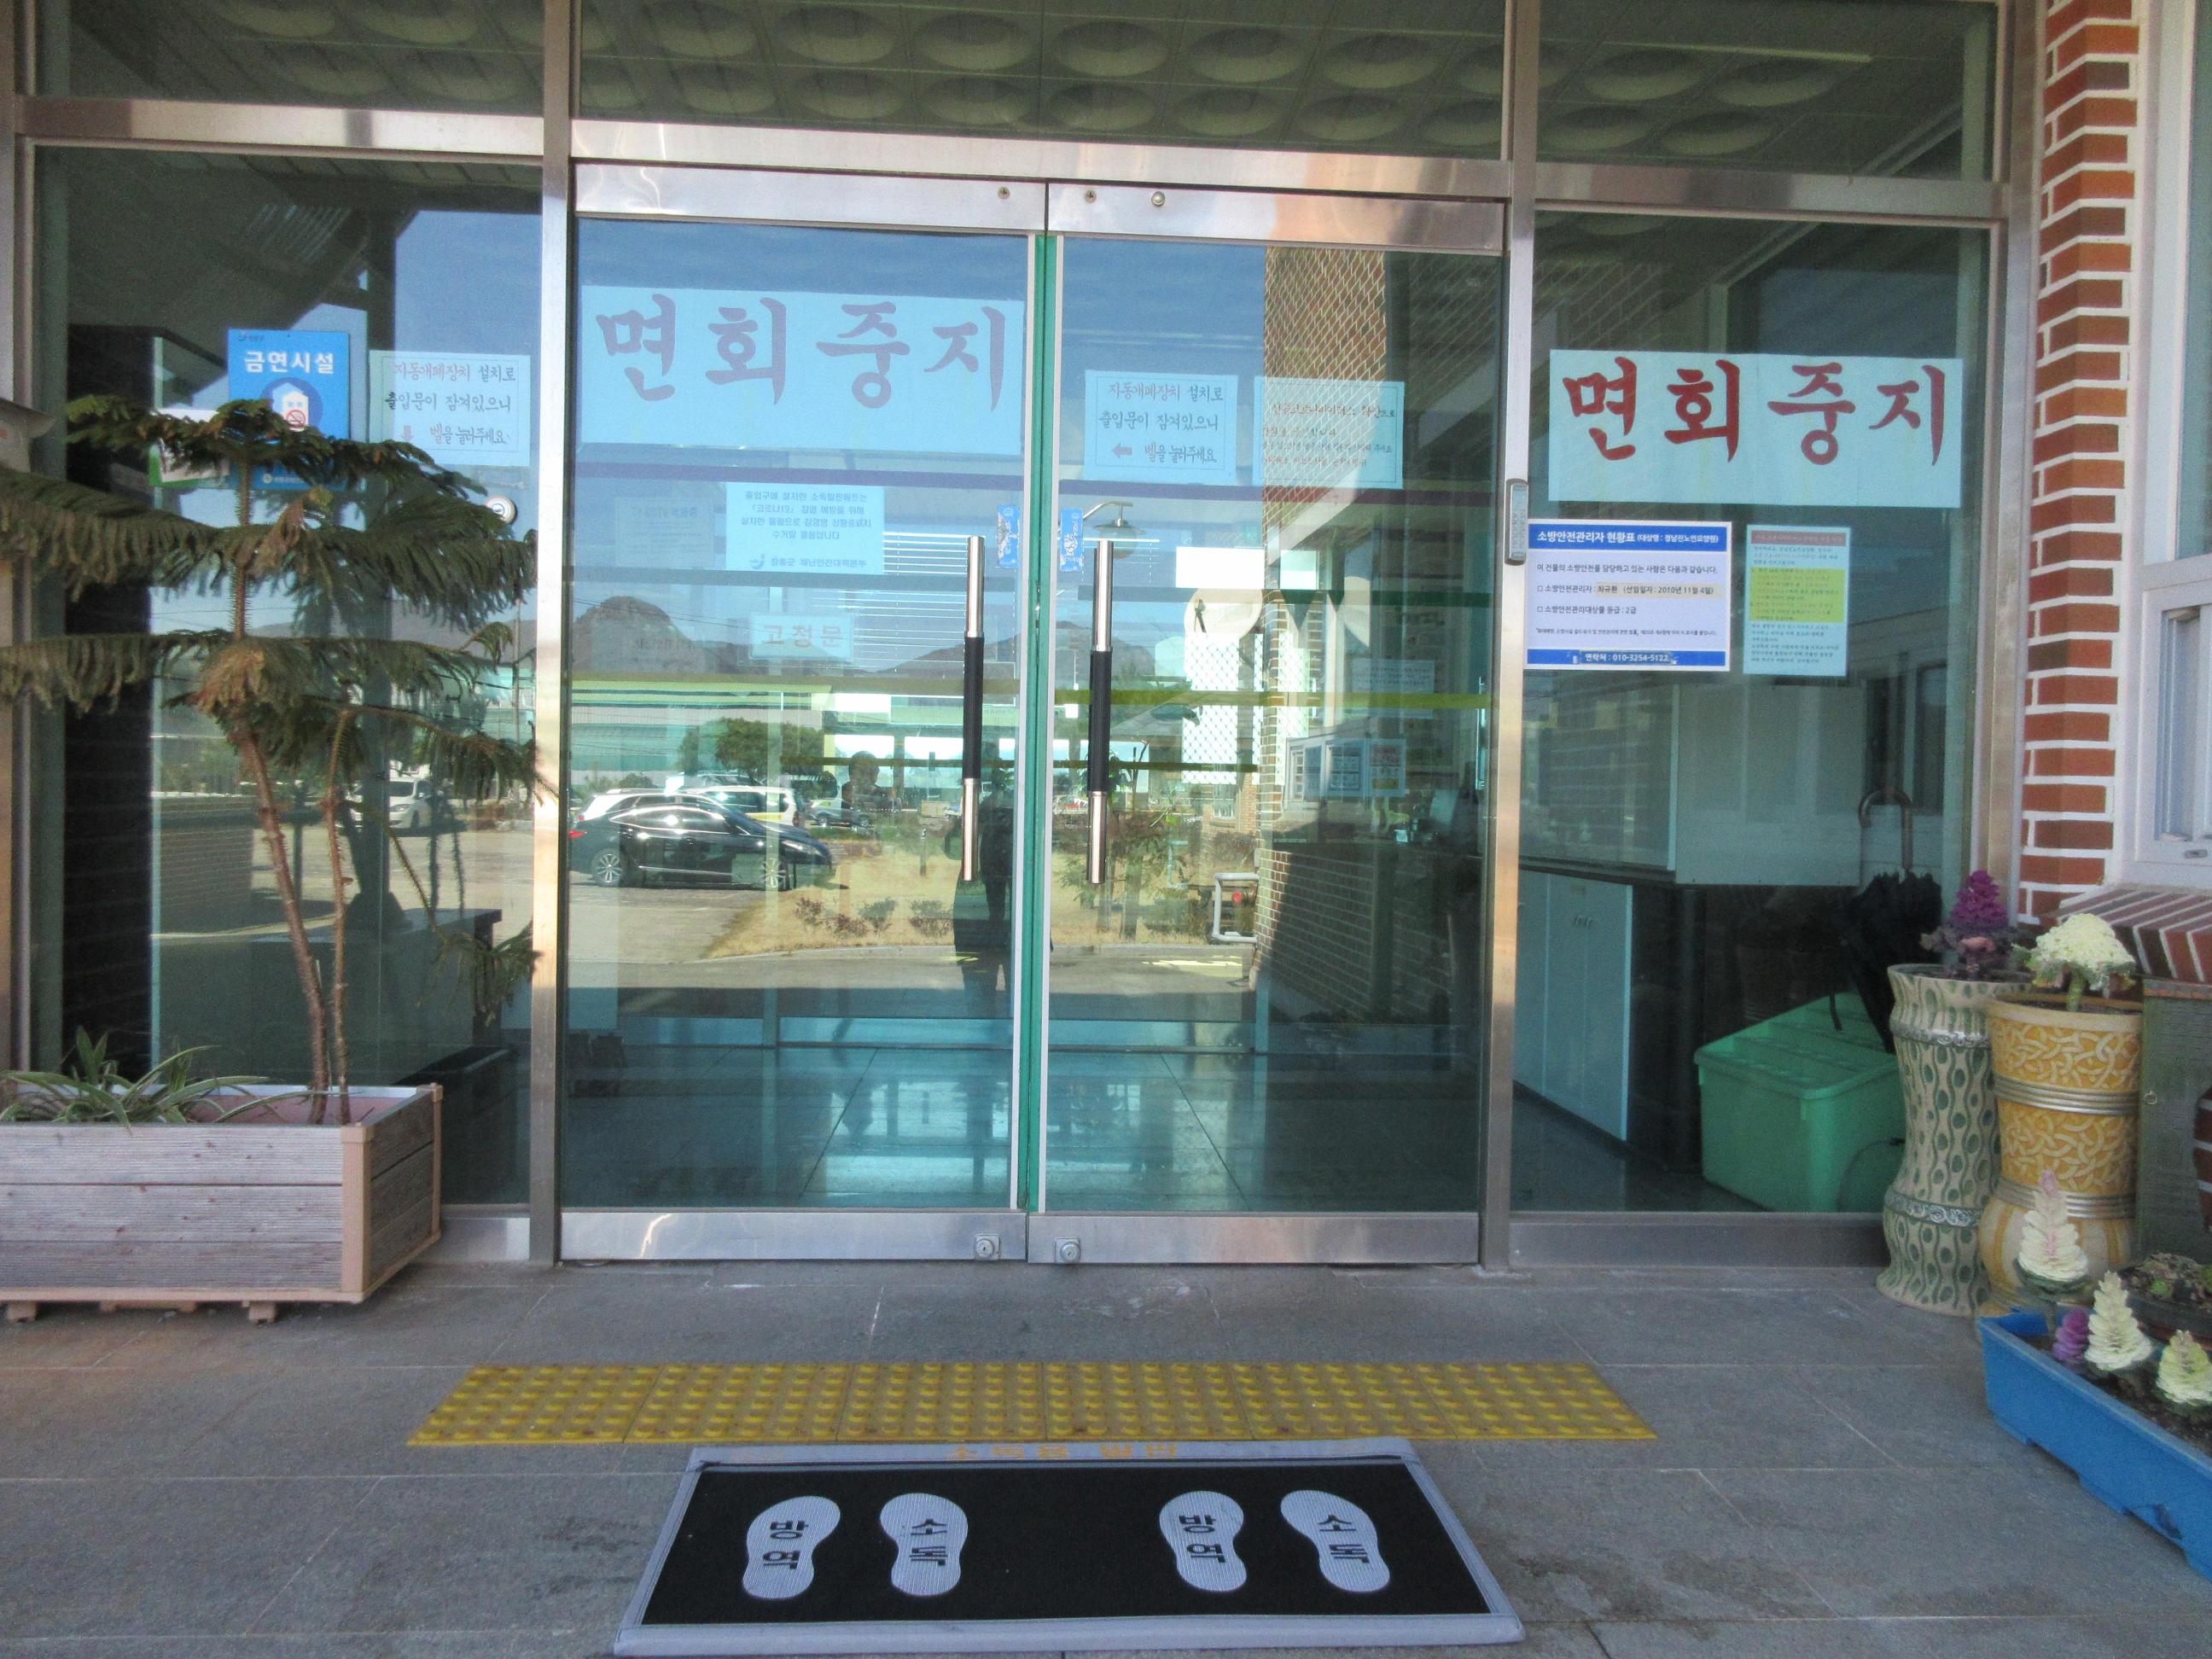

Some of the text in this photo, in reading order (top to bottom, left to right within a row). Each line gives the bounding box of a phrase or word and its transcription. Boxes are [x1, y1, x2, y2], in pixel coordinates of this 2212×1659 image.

[244, 350, 335, 375] 금연시설
[595, 293, 1006, 411] 면회중지
[394, 362, 515, 382] 자동개폐장치 설치로
[385, 392, 511, 412] 출입문이 잠겨있으니
[1109, 382, 1224, 403] 자동개폐장치 설치로
[1098, 411, 1219, 432] 출입문이 잠겨있으니
[1562, 356, 1947, 466] 면회중지
[430, 422, 452, 445] 벨을
[1144, 442, 1166, 463] 벨을
[1537, 530, 1605, 543] 소방안전관리자
[1607, 532, 1635, 544] 현황표
[1567, 564, 1600, 573] 소방안전을
[1603, 565, 1629, 573] 담당하고
[1632, 565, 1644, 573] 있는
[1646, 565, 1666, 573] 사람은
[1668, 566, 1688, 574] 다음과
[1545, 585, 1592, 593] 소방안전관리자
[1607, 606, 1621, 614] 등급
[762, 1519, 809, 1569] 방역
[908, 1517, 949, 1566] 소독
[1179, 1514, 1227, 1563] 방역
[1317, 1513, 1371, 1563] 소독
